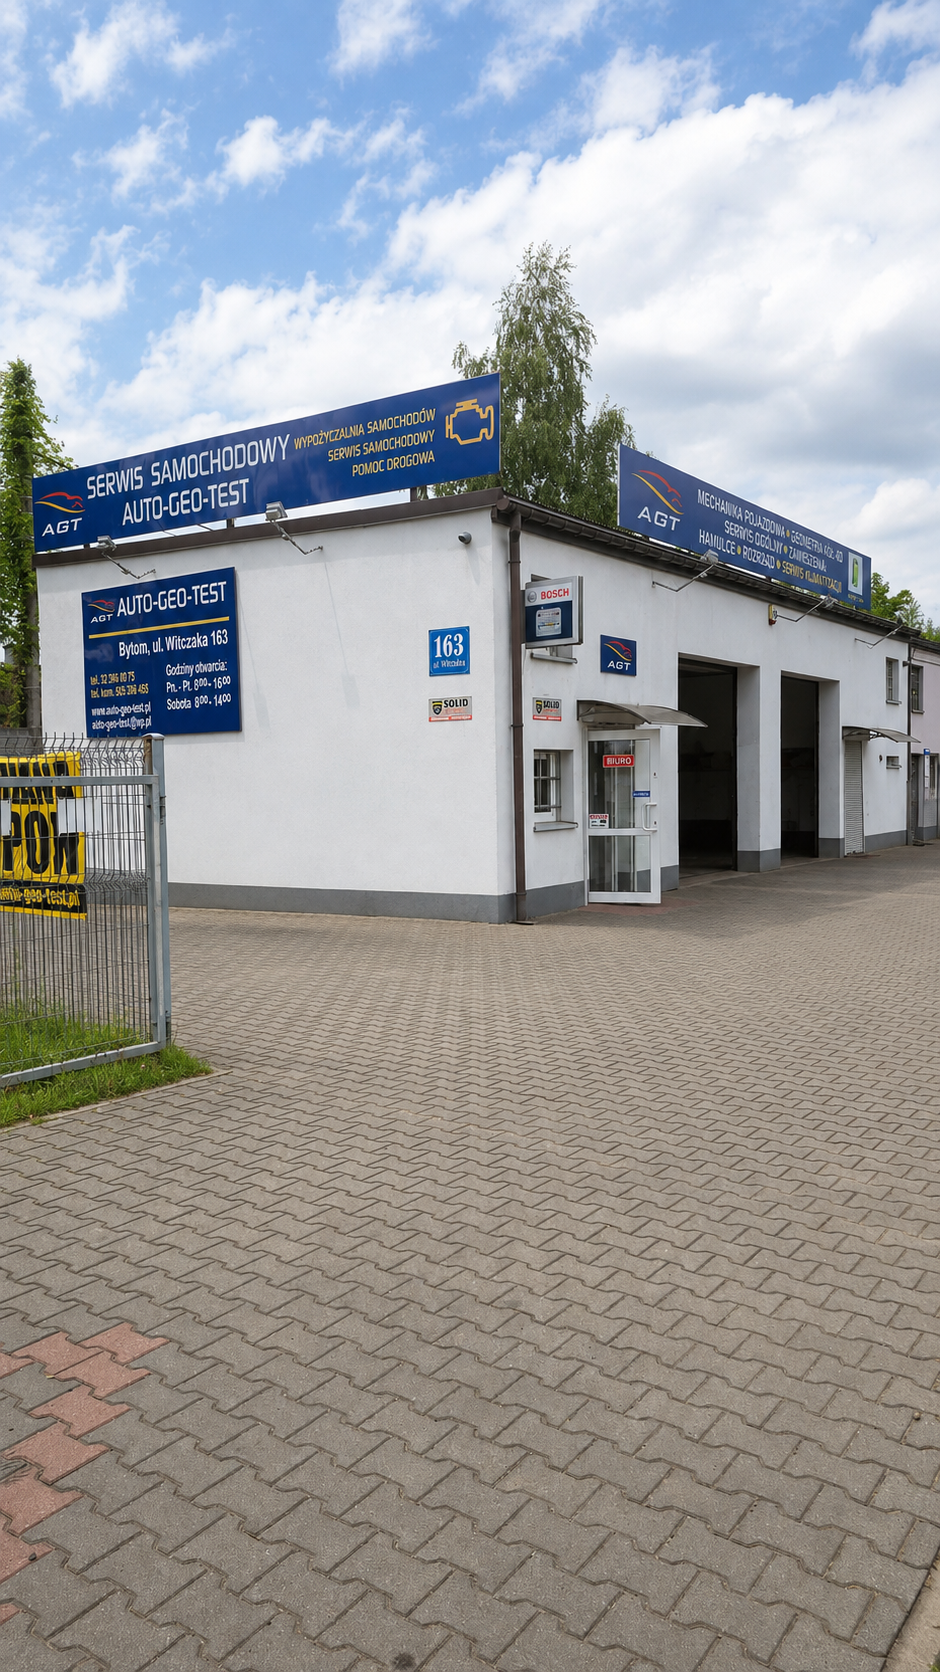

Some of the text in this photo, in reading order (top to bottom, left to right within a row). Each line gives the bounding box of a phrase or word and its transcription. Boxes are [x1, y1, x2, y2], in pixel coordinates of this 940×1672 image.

[294, 407, 436, 450] WYPOŻYCZALNIA SAMOCHODÓW
[328, 429, 435, 462] SERWIS SAMOCHODOWY
[87, 434, 291, 500] SERWIS SAMOCHODOWY
[352, 450, 435, 477] POMOC DROGOWA
[122, 478, 249, 526] AUTO-GEO-TEST
[42, 517, 83, 537] AGT
[637, 505, 681, 531] AGT
[699, 529, 736, 555] HAMULCE
[724, 520, 754, 543] SERWIS
[117, 581, 227, 617] AUTO-GEO-TEST
[540, 588, 570, 600] BOSCH
[90, 613, 113, 624] AGT
[119, 628, 228, 660] Bytom, ul. Witczaka 163
[433, 633, 464, 658] 163
[165, 662, 194, 678] Godziny
[607, 660, 632, 671] AGT
[166, 698, 192, 710] Sobota
[443, 698, 468, 708] SOLID
[606, 757, 632, 765] BIURO
